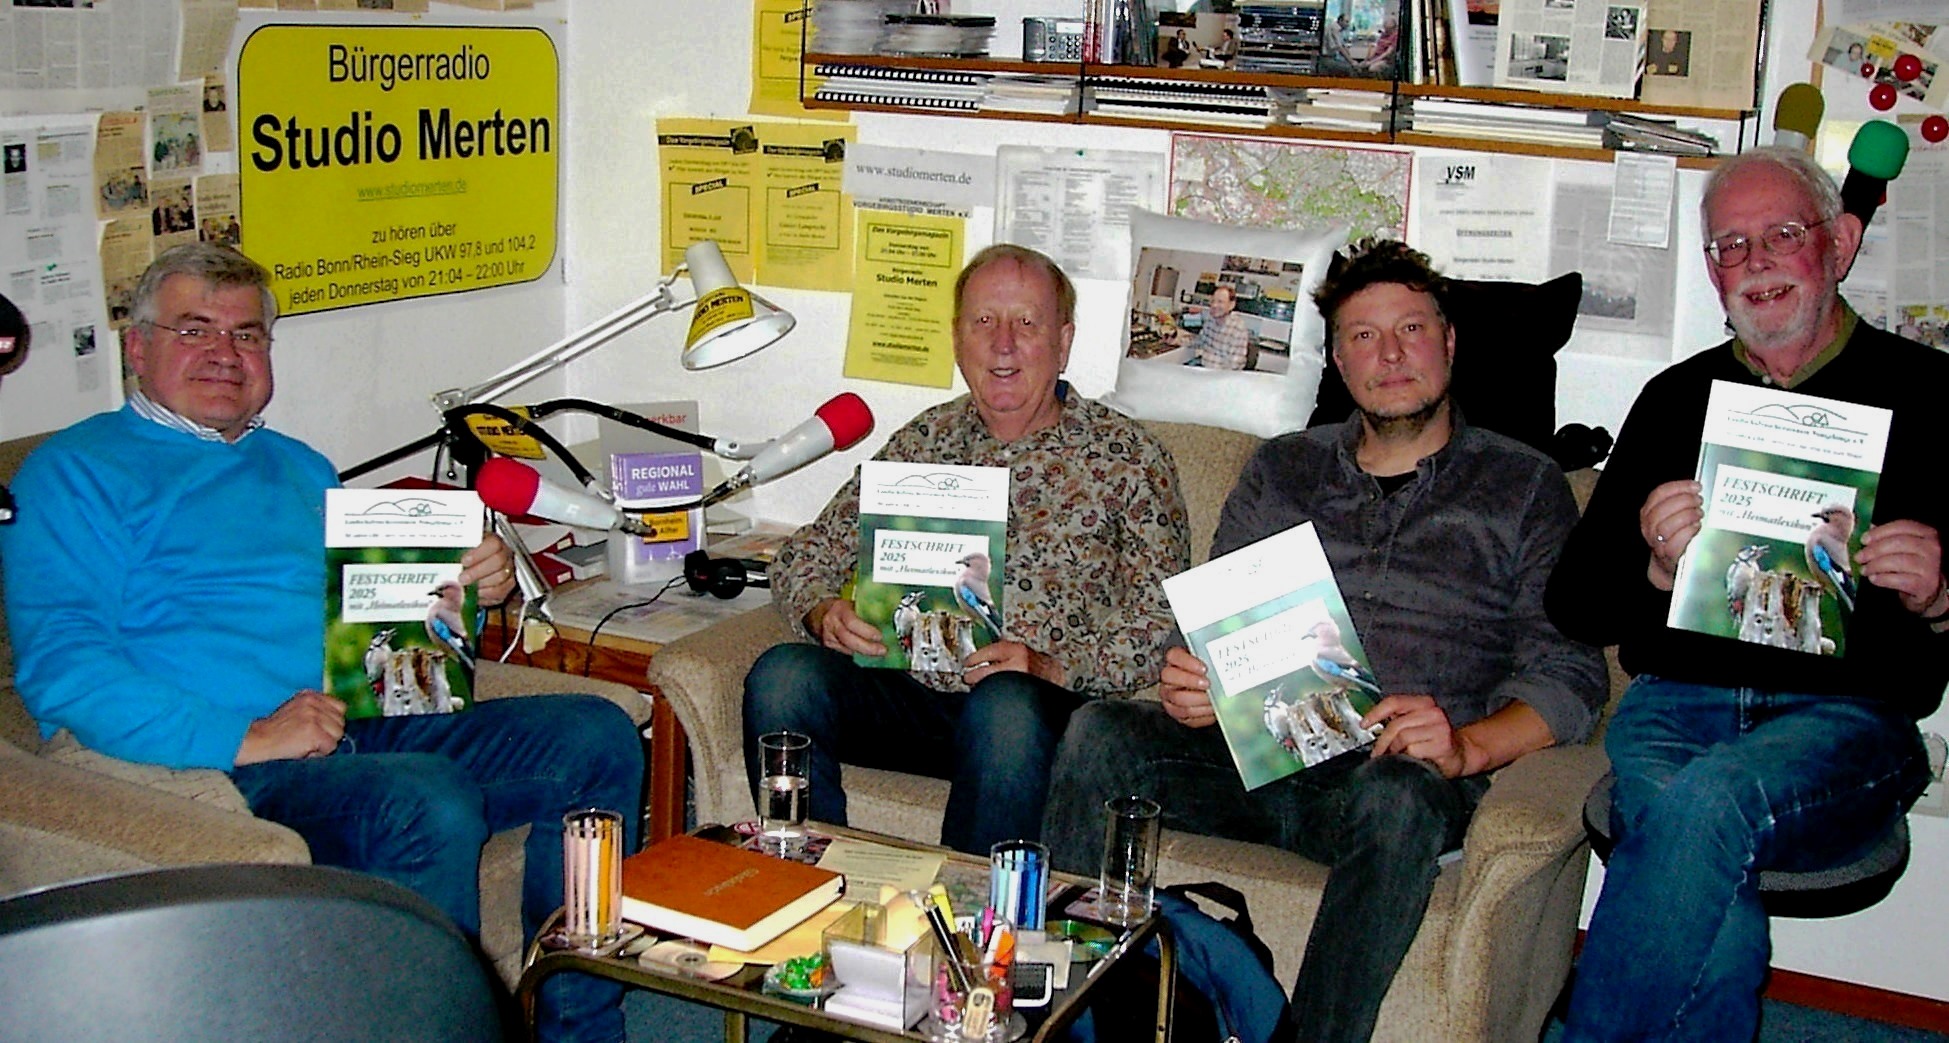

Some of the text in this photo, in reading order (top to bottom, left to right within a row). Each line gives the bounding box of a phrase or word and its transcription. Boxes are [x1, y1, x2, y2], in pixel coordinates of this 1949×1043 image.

[329, 44, 490, 91] Bürgerradio
[251, 108, 550, 172] Studio Merten
[856, 164, 972, 185] www.studiomerten.de
[1446, 165, 1476, 181] VSM
[357, 179, 467, 200] www.studiomerten.de
[694, 180, 724, 195] SPECIAL
[372, 222, 456, 244] zu hören über
[275, 235, 536, 281] Radio Bonn/Rhein-Sieg UKW 97,8 und 104,2
[288, 283, 324, 309] jeden
[328, 277, 398, 302] Donnerstag
[402, 275, 424, 289] von
[429, 267, 462, 287] 21:04
[476, 261, 503, 280] 22:00
[507, 260, 525, 276] Uhr
[876, 273, 938, 287] Studio Merten
[632, 464, 694, 480] REGIONAL
[636, 482, 656, 497] gute
[658, 480, 690, 492] WAHL
[1723, 477, 1829, 506] FESTSCHRIFT
[1720, 492, 1753, 508] 2025
[880, 538, 966, 554] FESTSCHRIFT
[880, 552, 906, 563] 2025
[349, 573, 438, 586] FESTSCHRIFT
[349, 588, 376, 600] 2025
